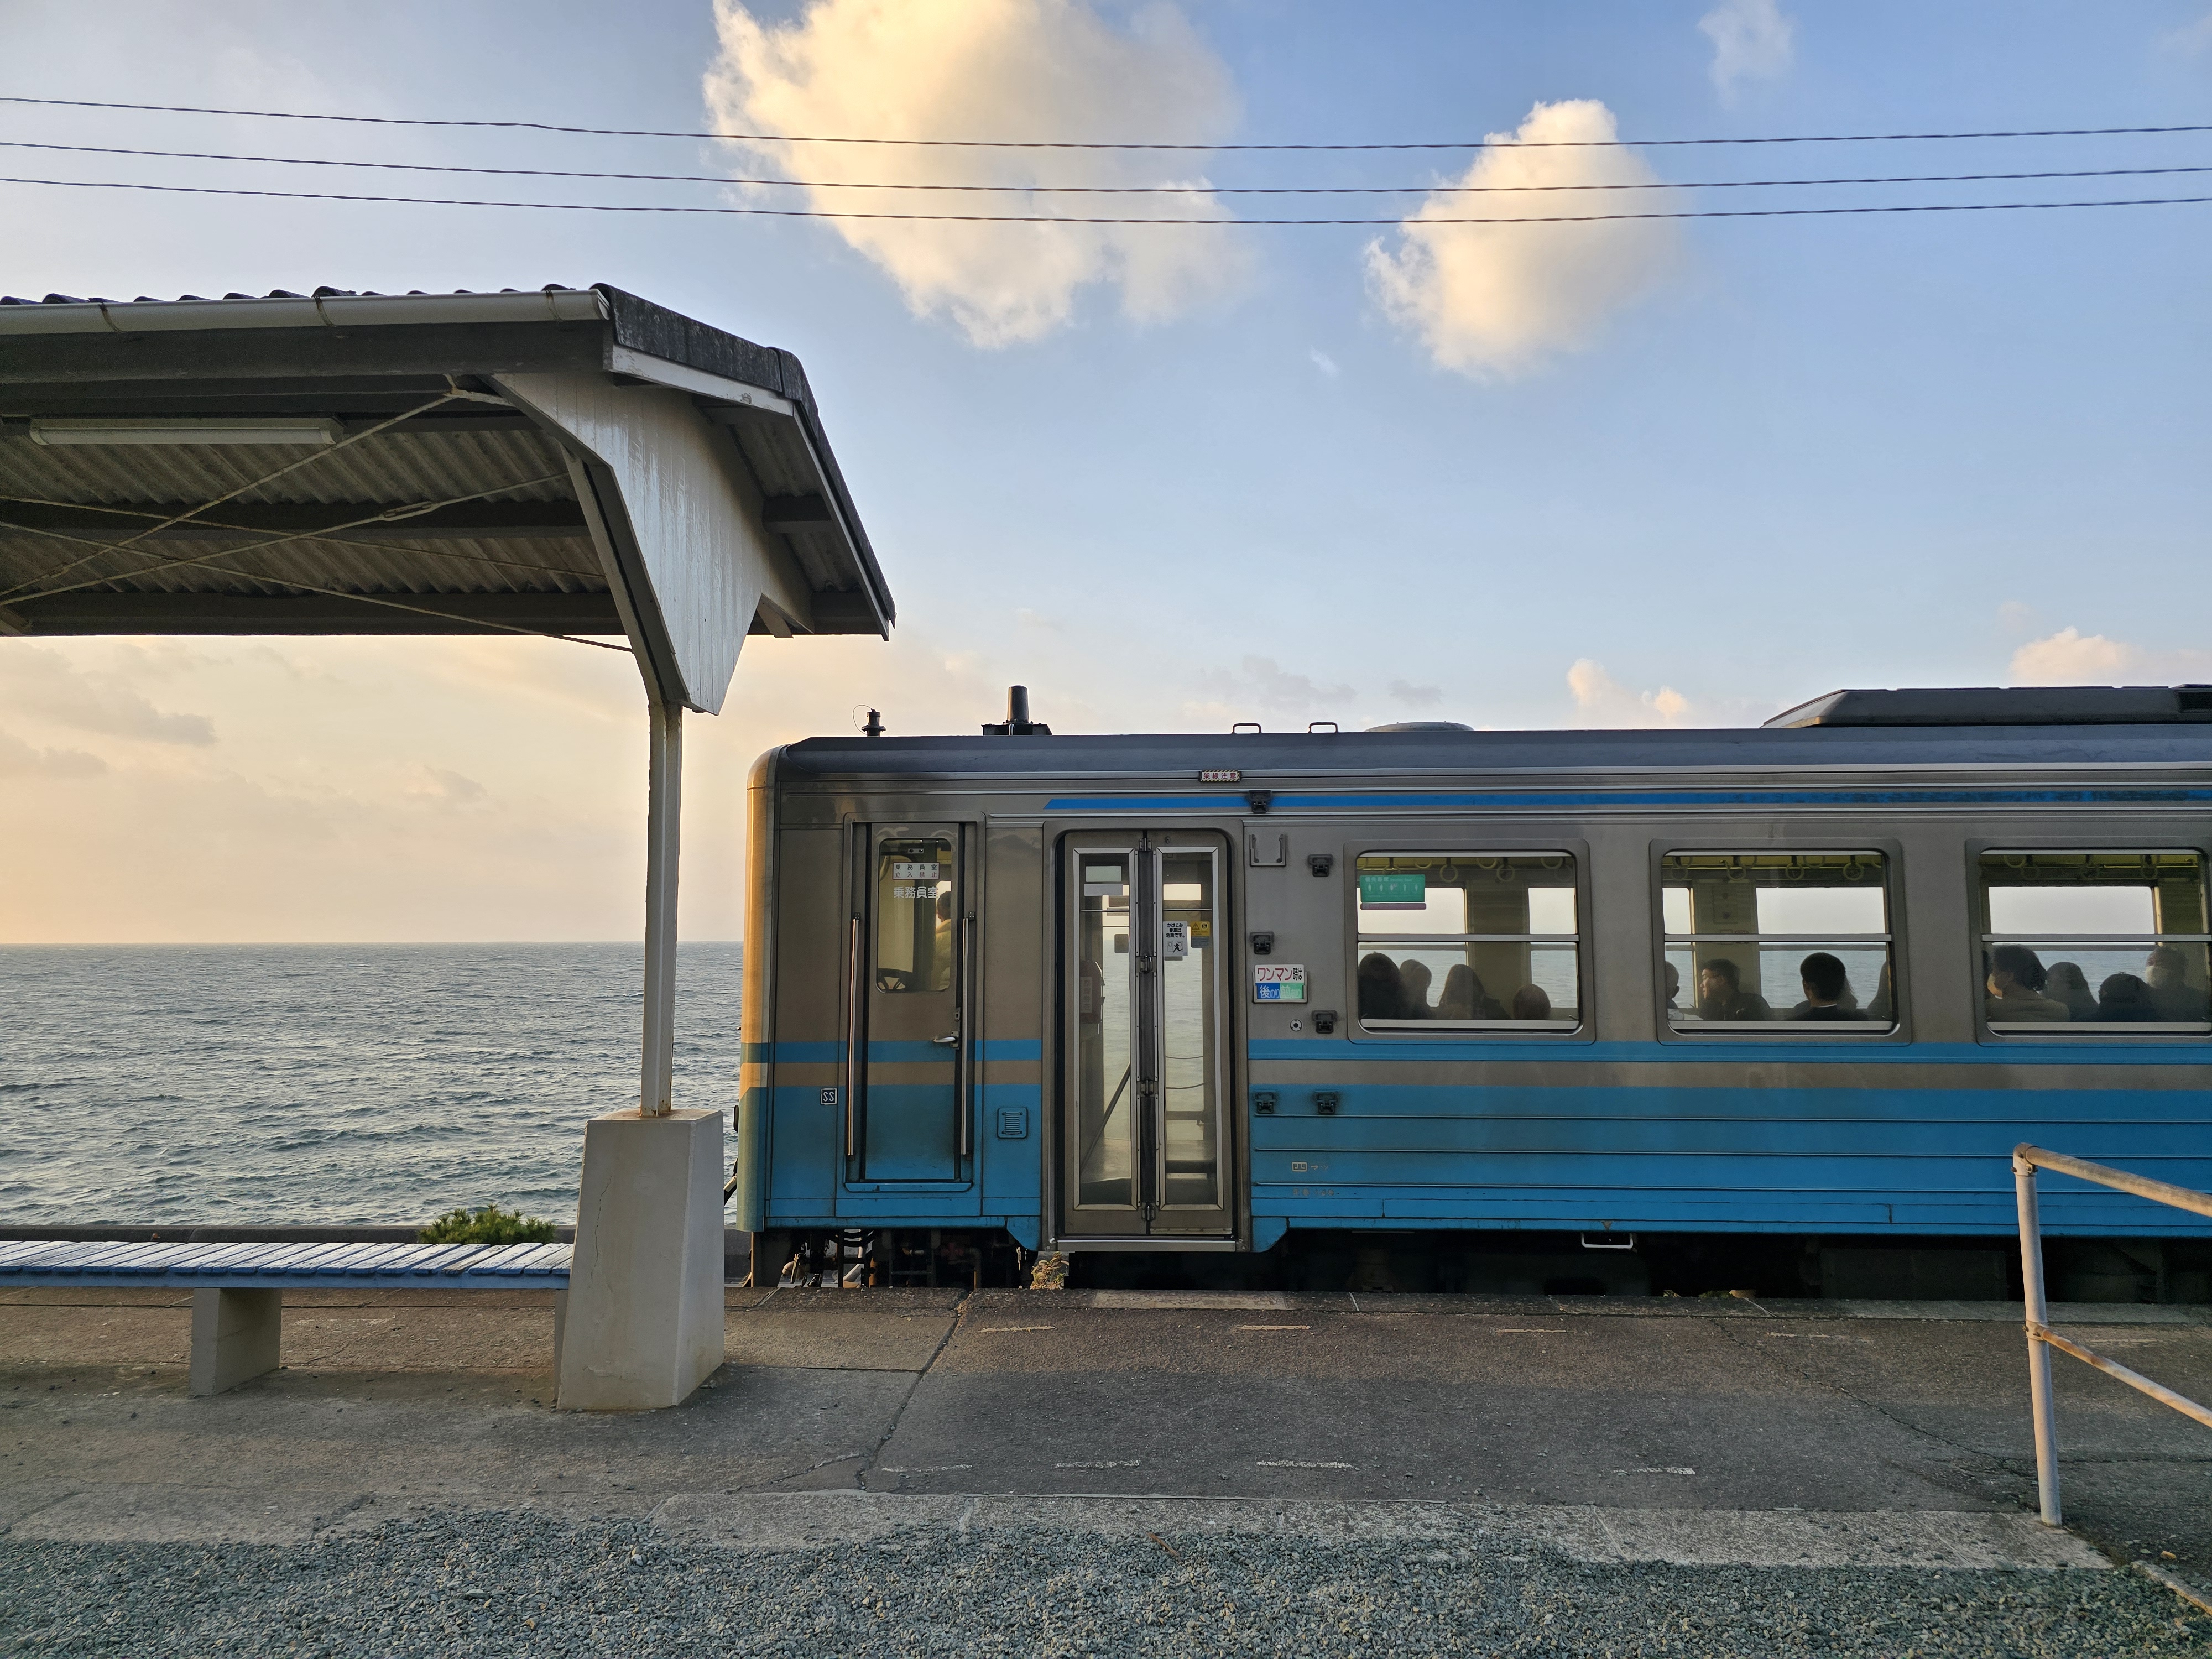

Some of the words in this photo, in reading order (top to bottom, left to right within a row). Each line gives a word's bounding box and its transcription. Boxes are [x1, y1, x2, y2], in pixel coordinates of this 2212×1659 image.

[894, 886, 938, 899] 乗務員室
[1259, 985, 1280, 998] 後のり
[823, 1091, 834, 1102] SS
